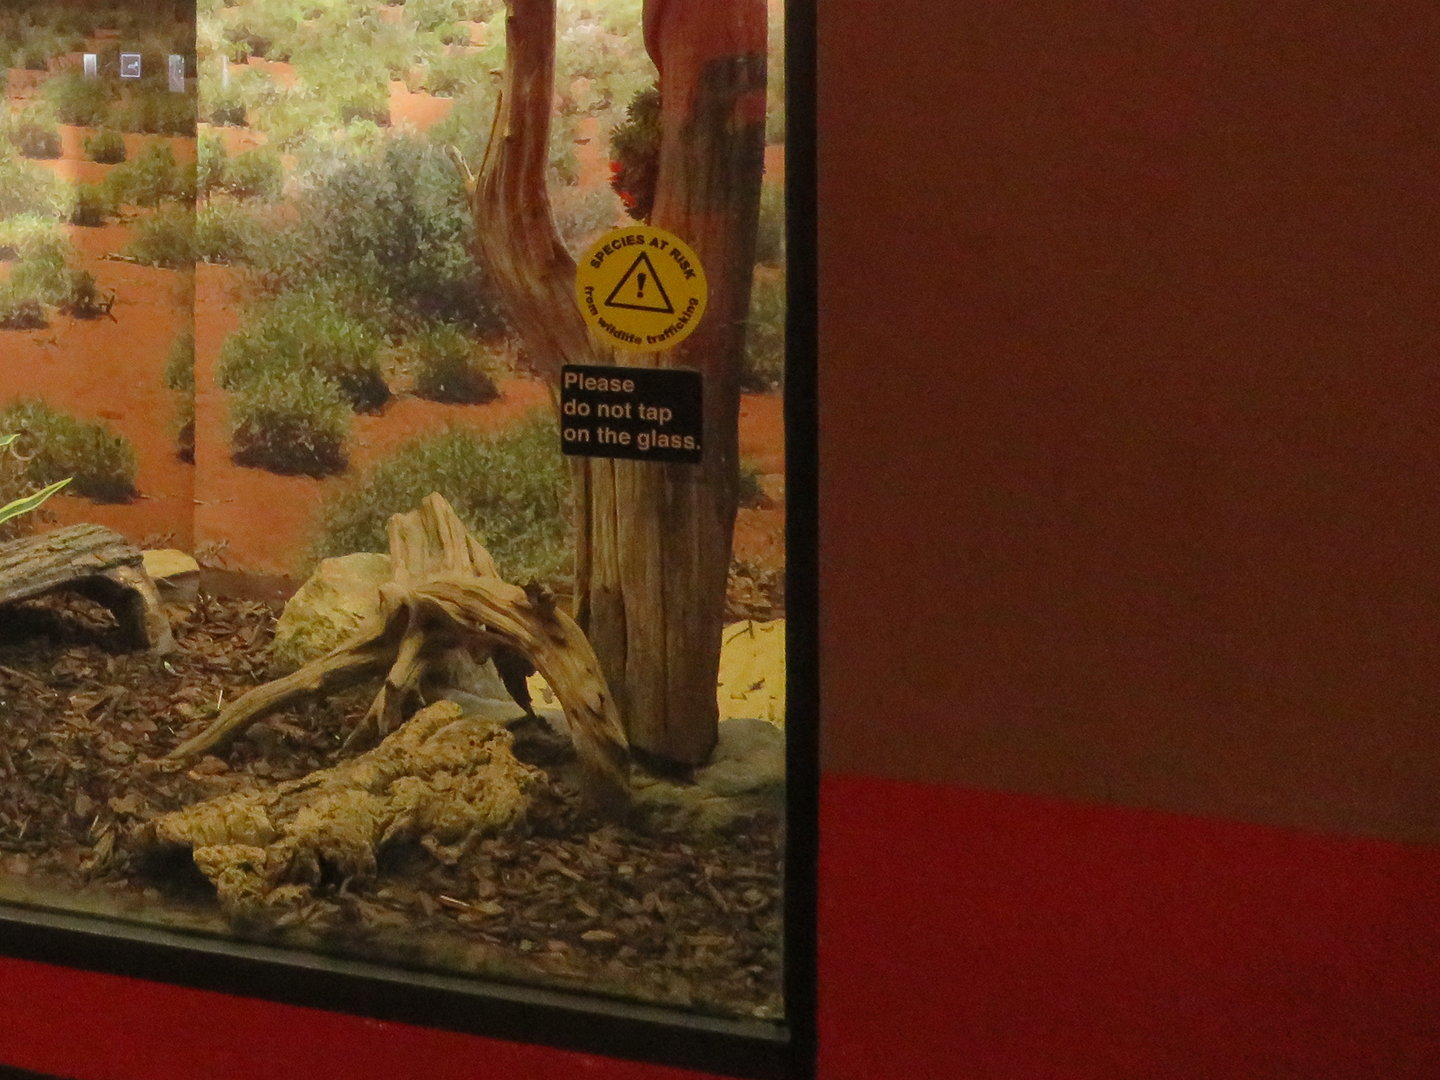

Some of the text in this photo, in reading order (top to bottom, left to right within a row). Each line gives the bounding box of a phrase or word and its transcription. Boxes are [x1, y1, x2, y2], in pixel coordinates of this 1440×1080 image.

[590, 234, 696, 281] SPECIES AT RISK
[584, 285, 699, 345] from wildlife trafficking
[564, 372, 635, 393] Please
[564, 398, 673, 425] do not tap
[564, 426, 702, 451] on the glass.
